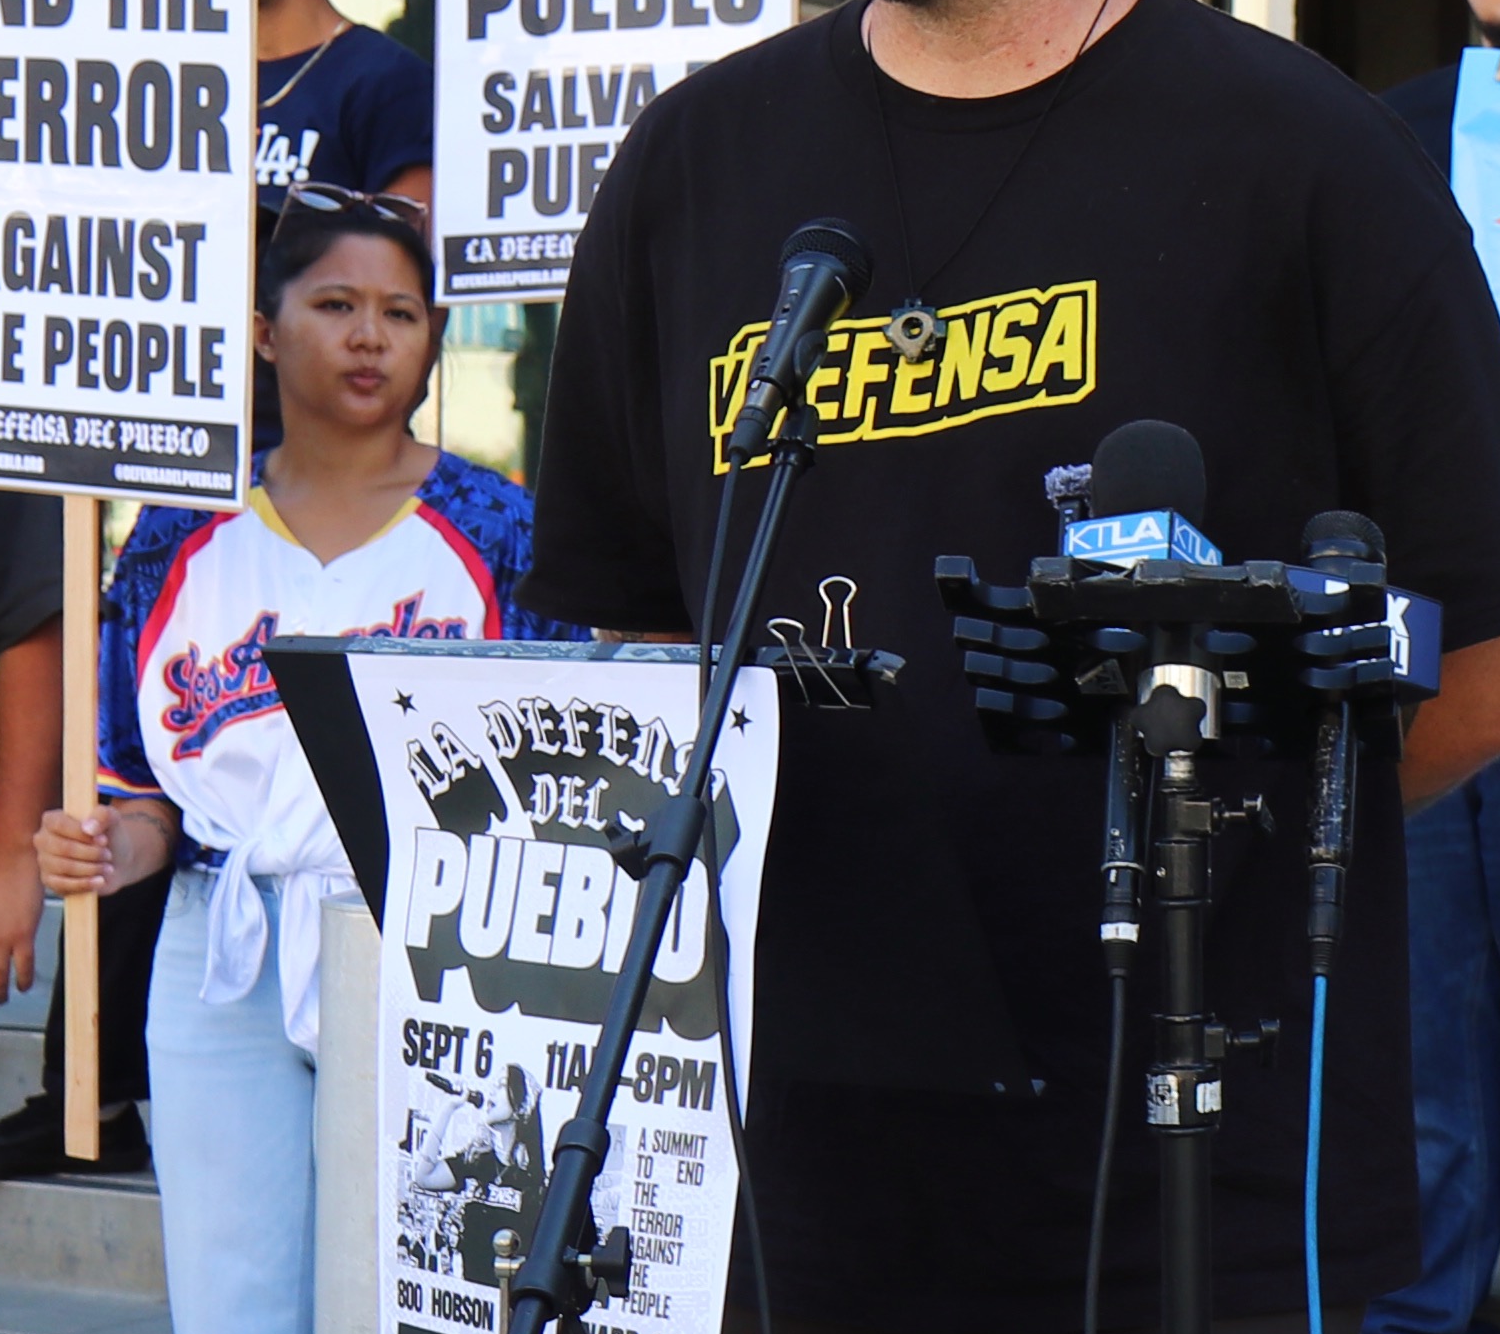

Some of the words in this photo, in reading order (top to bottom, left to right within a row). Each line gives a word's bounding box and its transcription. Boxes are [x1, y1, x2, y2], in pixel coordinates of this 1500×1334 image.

[481, 63, 657, 134] SALVA
[500, 233, 575, 261] DEFEN
[44, 315, 225, 400] PEOPLE
[722, 295, 1084, 434] EFENSA
[1068, 516, 1164, 552] KTLA
[1174, 517, 1219, 566] KTLA
[406, 721, 483, 800] LA
[526, 772, 611, 832] DEL
[402, 1018, 469, 1074] SEPT
[475, 1029, 494, 1079] 6
[546, 1040, 718, 1112] 11A-8PM
[637, 1127, 647, 1152] A
[652, 1129, 709, 1160] SUMMIT
[633, 1180, 659, 1208] THE
[636, 1153, 653, 1179] TO
[676, 1159, 704, 1187] END
[630, 1207, 684, 1238] TERROR
[398, 1277, 423, 1314] 800
[431, 1286, 494, 1332] HOBSON
[623, 1290, 673, 1319] PEOPLE
